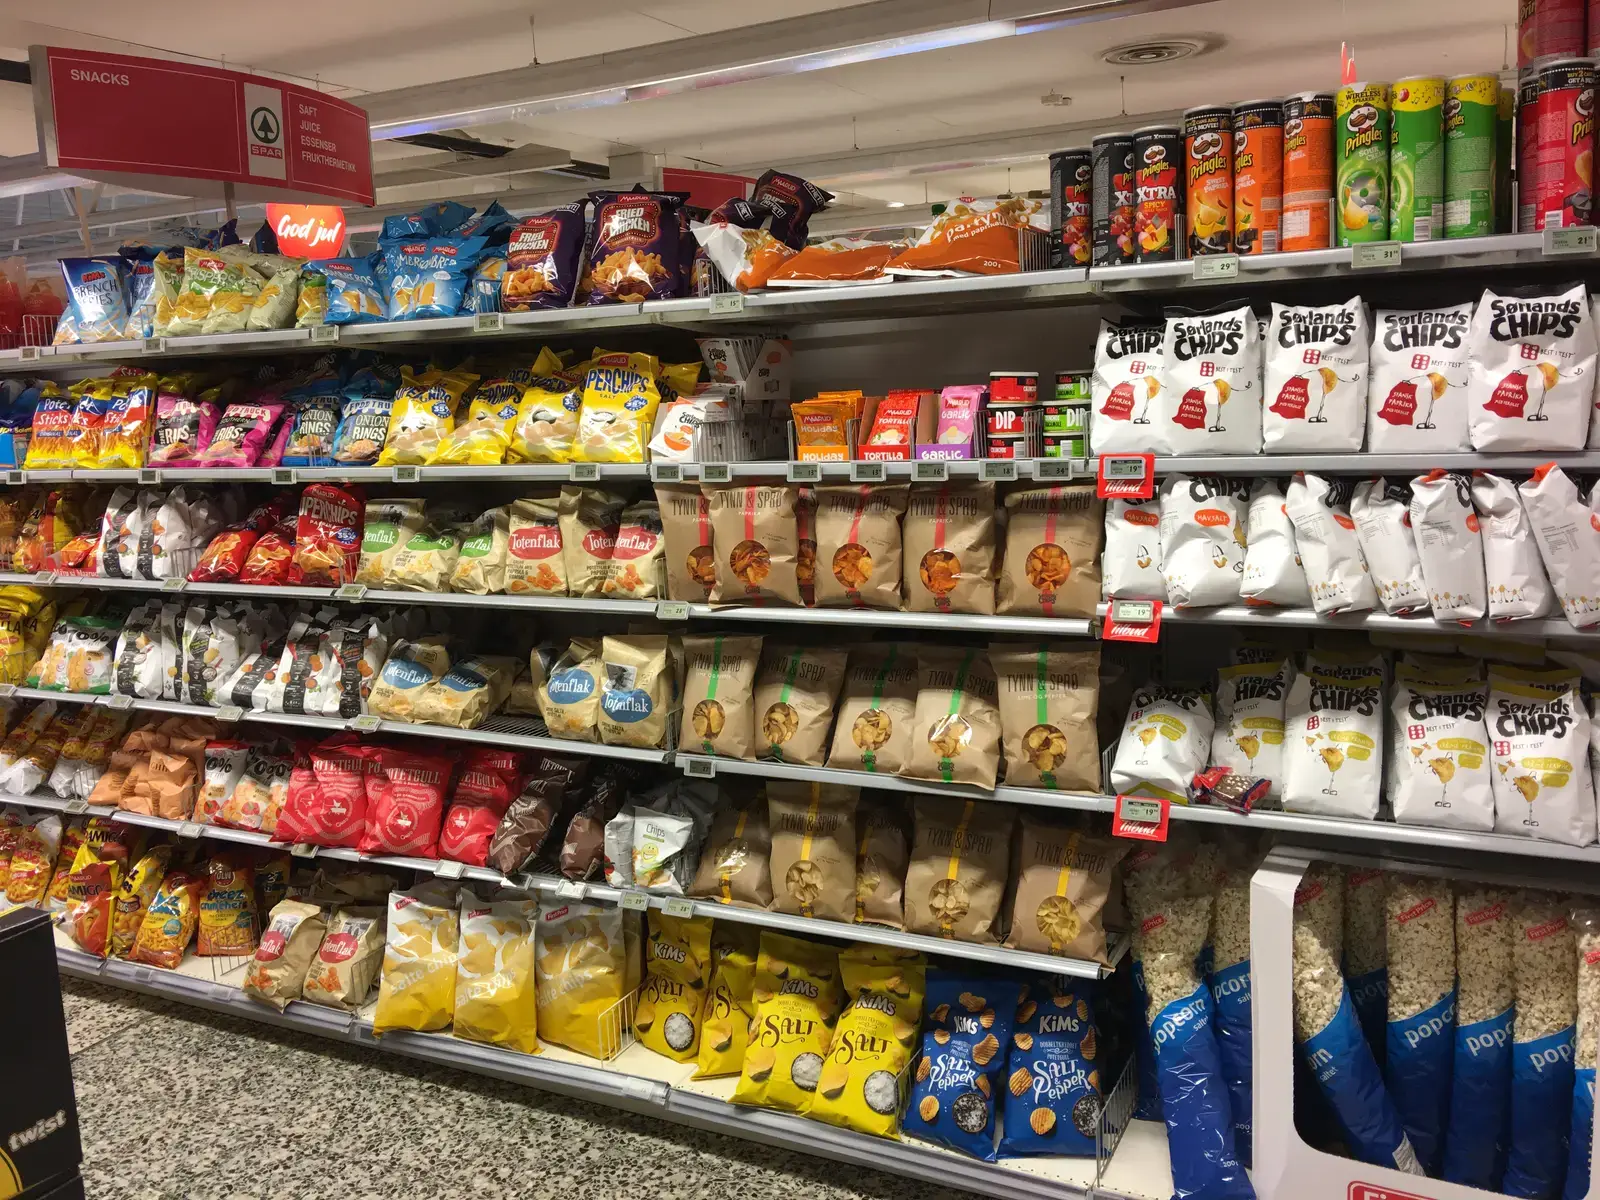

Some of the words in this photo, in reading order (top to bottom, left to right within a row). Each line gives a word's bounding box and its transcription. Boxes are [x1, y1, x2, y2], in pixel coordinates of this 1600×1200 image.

[71, 69, 129, 86] SNACKS
[1346, 91, 1381, 99] WIRELESS
[299, 104, 317, 117] SAFT
[300, 120, 321, 134] JUICE
[251, 145, 282, 157] SPAR
[301, 136, 336, 152] ESSENSER
[1345, 127, 1382, 159] Pringles
[302, 152, 356, 173] FRUKTHERMETIKK
[1142, 161, 1169, 182] Pringles
[1190, 154, 1226, 187] Pringles
[1137, 186, 1176, 203] XTRA
[616, 207, 644, 218] FRIED
[1144, 201, 1165, 209] SPICY
[277, 214, 314, 238] God
[313, 221, 341, 246] jul
[519, 230, 544, 242] FRIED
[509, 239, 549, 253] CHICKEN
[1278, 308, 1355, 329] Sørlands
[1490, 299, 1581, 319] Sørlands
[1173, 316, 1244, 339] Sørlands
[1384, 310, 1469, 330] Sørlands
[1490, 312, 1581, 342] CHIPS
[1173, 331, 1244, 361] CHIPS
[1277, 324, 1357, 349] CHIPS
[1383, 322, 1469, 352] CHIPS
[38, 413, 67, 425] Sticks
[301, 410, 333, 421] ONION
[355, 416, 390, 427] ONION
[995, 410, 1016, 429] DIP
[217, 427, 243, 441] RIBS
[300, 423, 332, 435] RINGS
[353, 427, 386, 440] RINGS
[1104, 479, 1145, 494] Tilbud
[673, 499, 697, 516] TYNN
[718, 490, 742, 509] TYNN
[830, 495, 856, 512] TYNN
[909, 498, 935, 517] TYNN
[1020, 492, 1047, 510] TYNN
[1197, 513, 1229, 523] HAVSALT
[511, 532, 561, 550] Totenflak
[1110, 624, 1150, 639] Tilbud
[1006, 673, 1033, 692] TYNN
[603, 692, 650, 713] Totenflak
[1309, 689, 1379, 716] CHIPS
[1407, 700, 1485, 722] CHIPS
[1495, 713, 1573, 739] CHIPS
[645, 822, 666, 839] Chips
[1400, 907, 1417, 922] First
[1417, 901, 1434, 914] Price
[1468, 912, 1485, 924] First
[1528, 925, 1547, 940] First
[1547, 919, 1567, 933] Price
[653, 942, 686, 964] KiMs
[389, 970, 425, 996] salte
[779, 979, 819, 999] KiMs
[855, 994, 896, 1016] KiMs
[760, 1014, 818, 1048] SALT
[954, 1015, 978, 1035] KiMs
[1038, 1014, 1080, 1035] KiMs
[1152, 995, 1205, 1056] popcorn
[835, 1029, 893, 1065] SALT
[937, 1053, 972, 1073] SALT
[1033, 1058, 1079, 1079] SALT
[8, 1109, 67, 1153] twist
